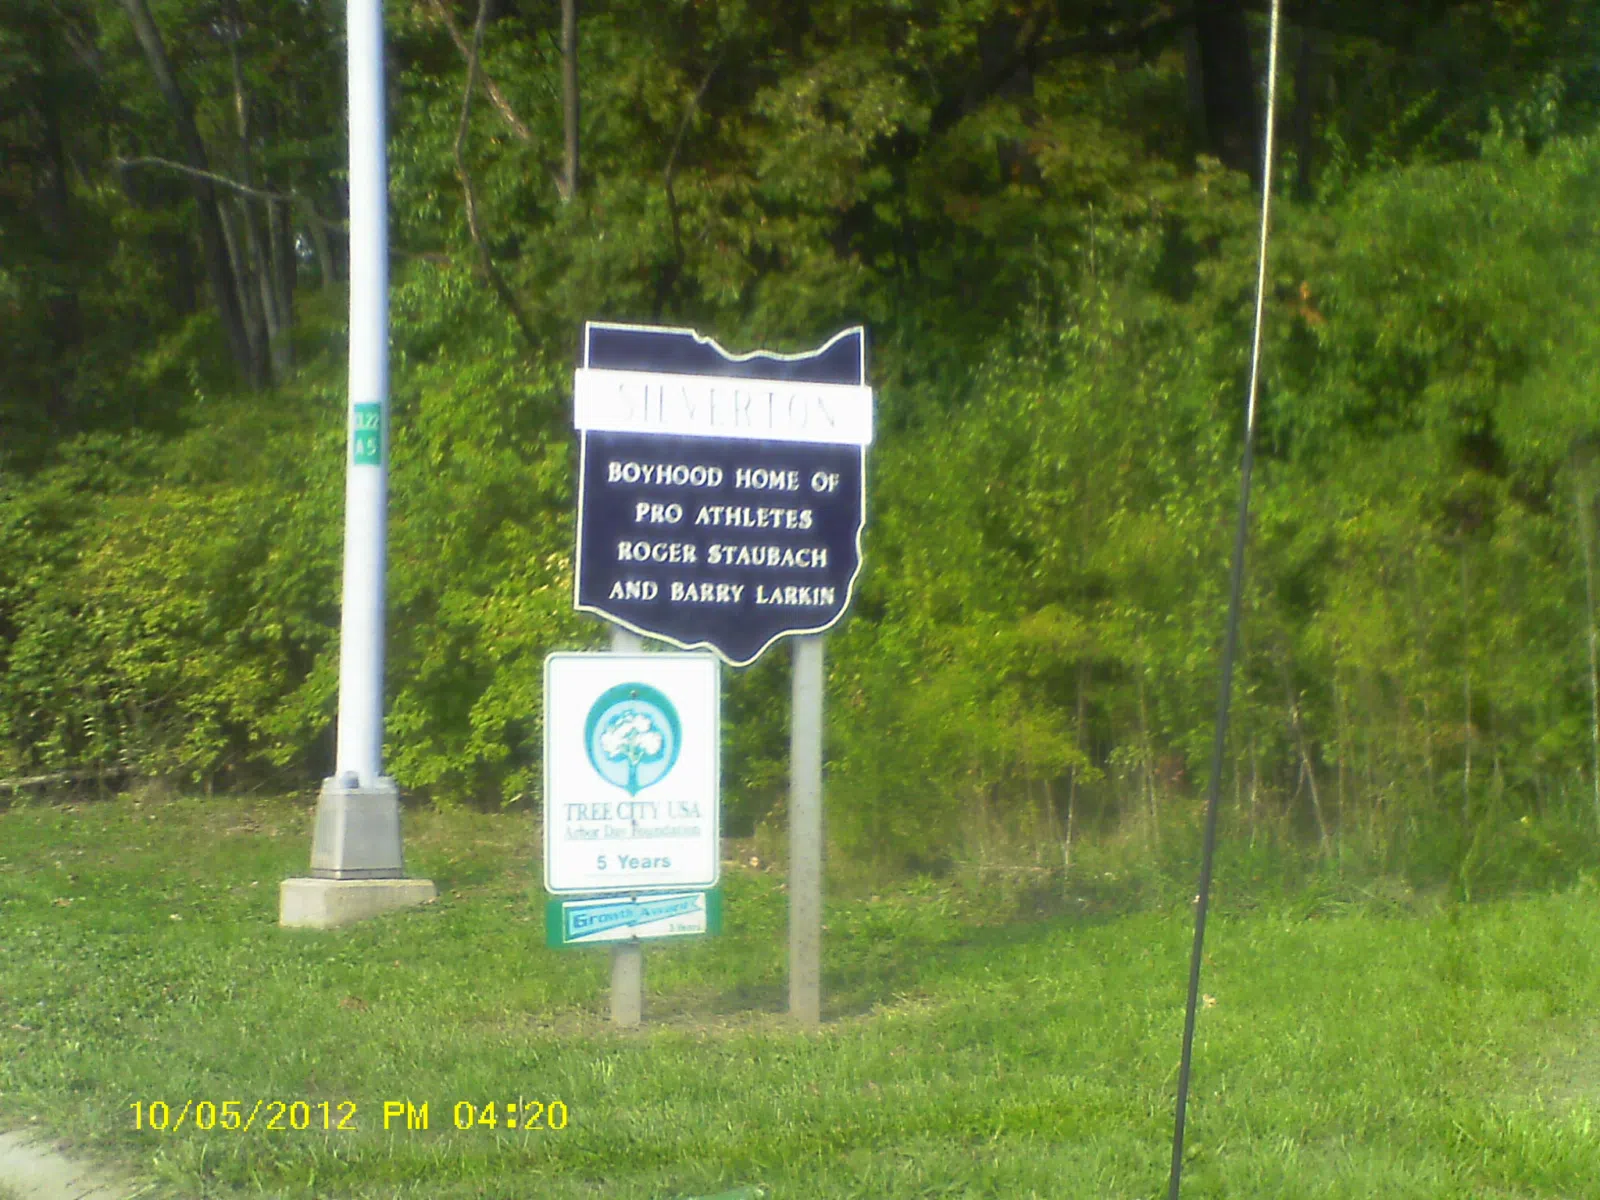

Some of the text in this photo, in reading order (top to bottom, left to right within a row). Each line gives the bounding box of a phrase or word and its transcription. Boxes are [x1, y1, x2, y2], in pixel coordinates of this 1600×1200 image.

[619, 383, 838, 430] SILVERTON
[608, 461, 840, 492] BOYHOOD HOME OF
[635, 502, 813, 529] PRO ATHLETES
[617, 541, 828, 568] ROGER STAUBACH
[609, 581, 836, 606] AND BARRY LARKIN
[564, 801, 703, 822] TREE CITY USA
[596, 854, 672, 870] 5 Years
[573, 909, 634, 929] Growth
